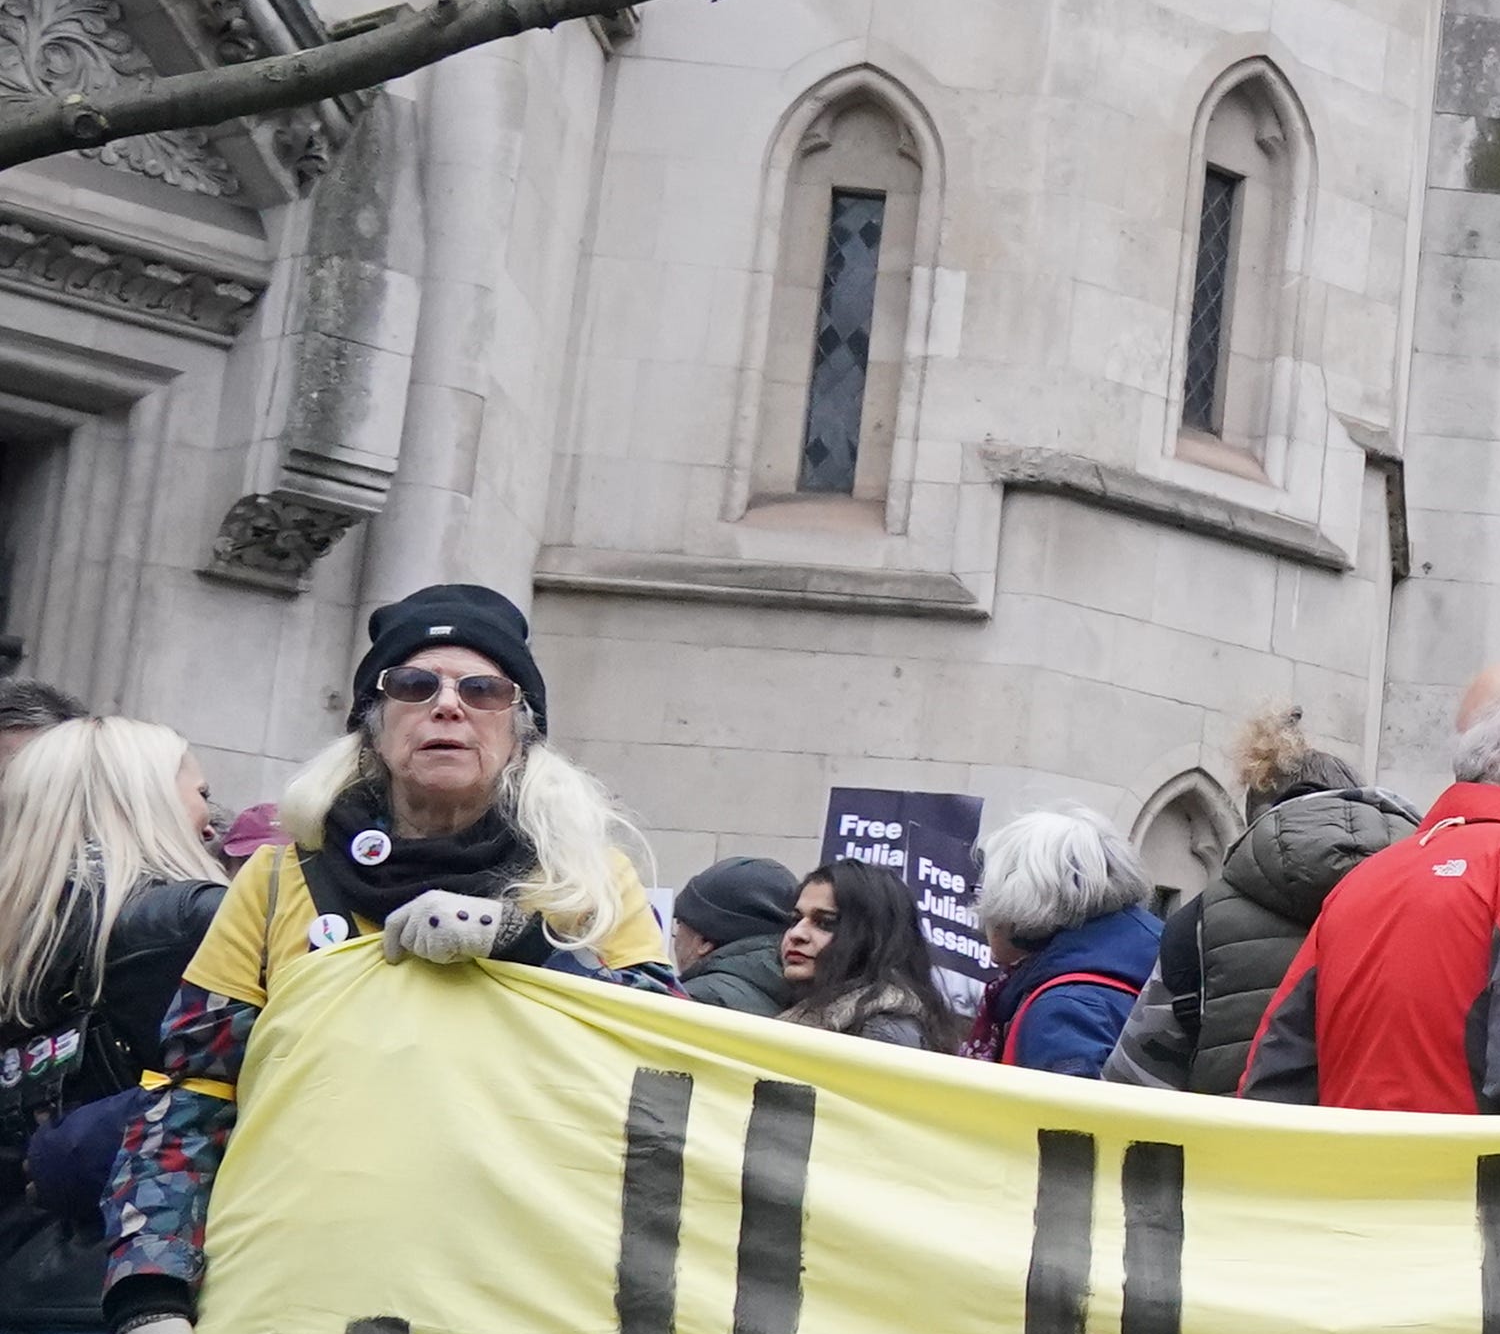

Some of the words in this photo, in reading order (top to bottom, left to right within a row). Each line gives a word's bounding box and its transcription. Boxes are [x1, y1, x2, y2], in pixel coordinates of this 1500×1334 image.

[839, 814, 903, 840] Free
[835, 841, 905, 867] Julia
[918, 856, 966, 894] Free
